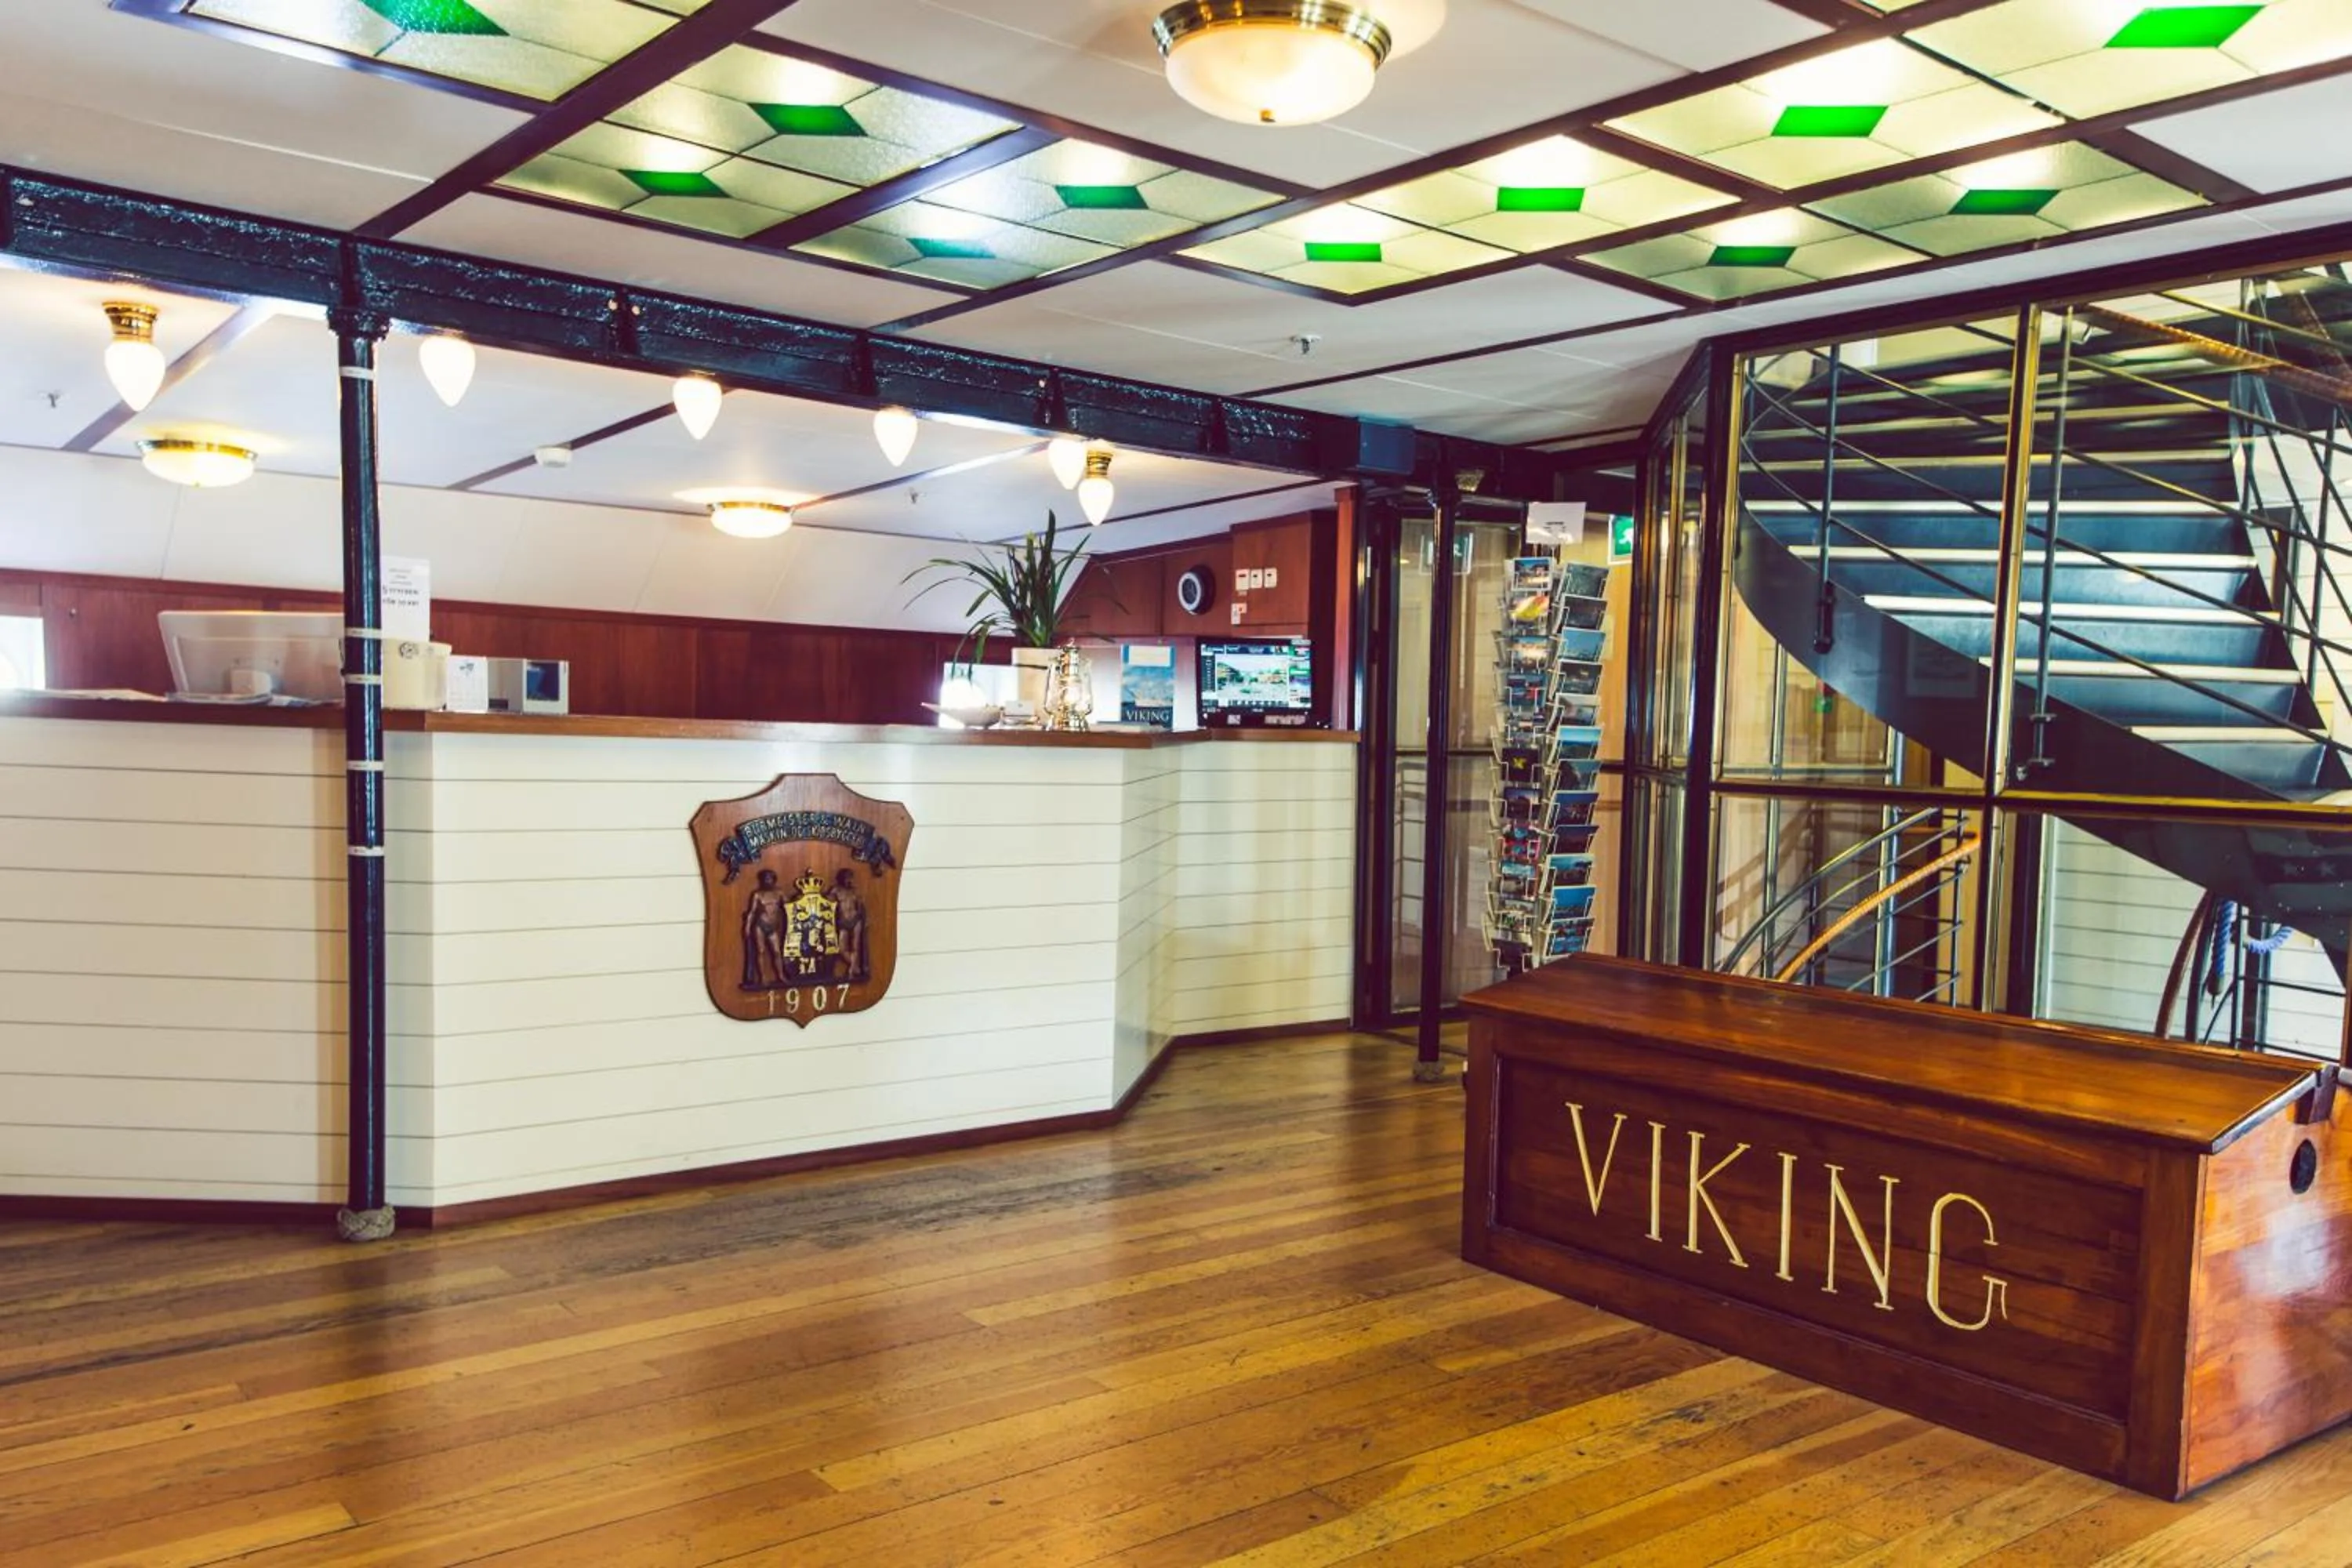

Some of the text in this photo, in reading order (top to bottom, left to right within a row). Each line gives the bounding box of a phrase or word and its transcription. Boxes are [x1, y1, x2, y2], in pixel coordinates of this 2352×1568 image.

[1126, 709, 1169, 722] VIKING
[833, 816, 866, 833] WAIN
[768, 982, 850, 1015] 1907
[1564, 1101, 2008, 1331] VIKING
